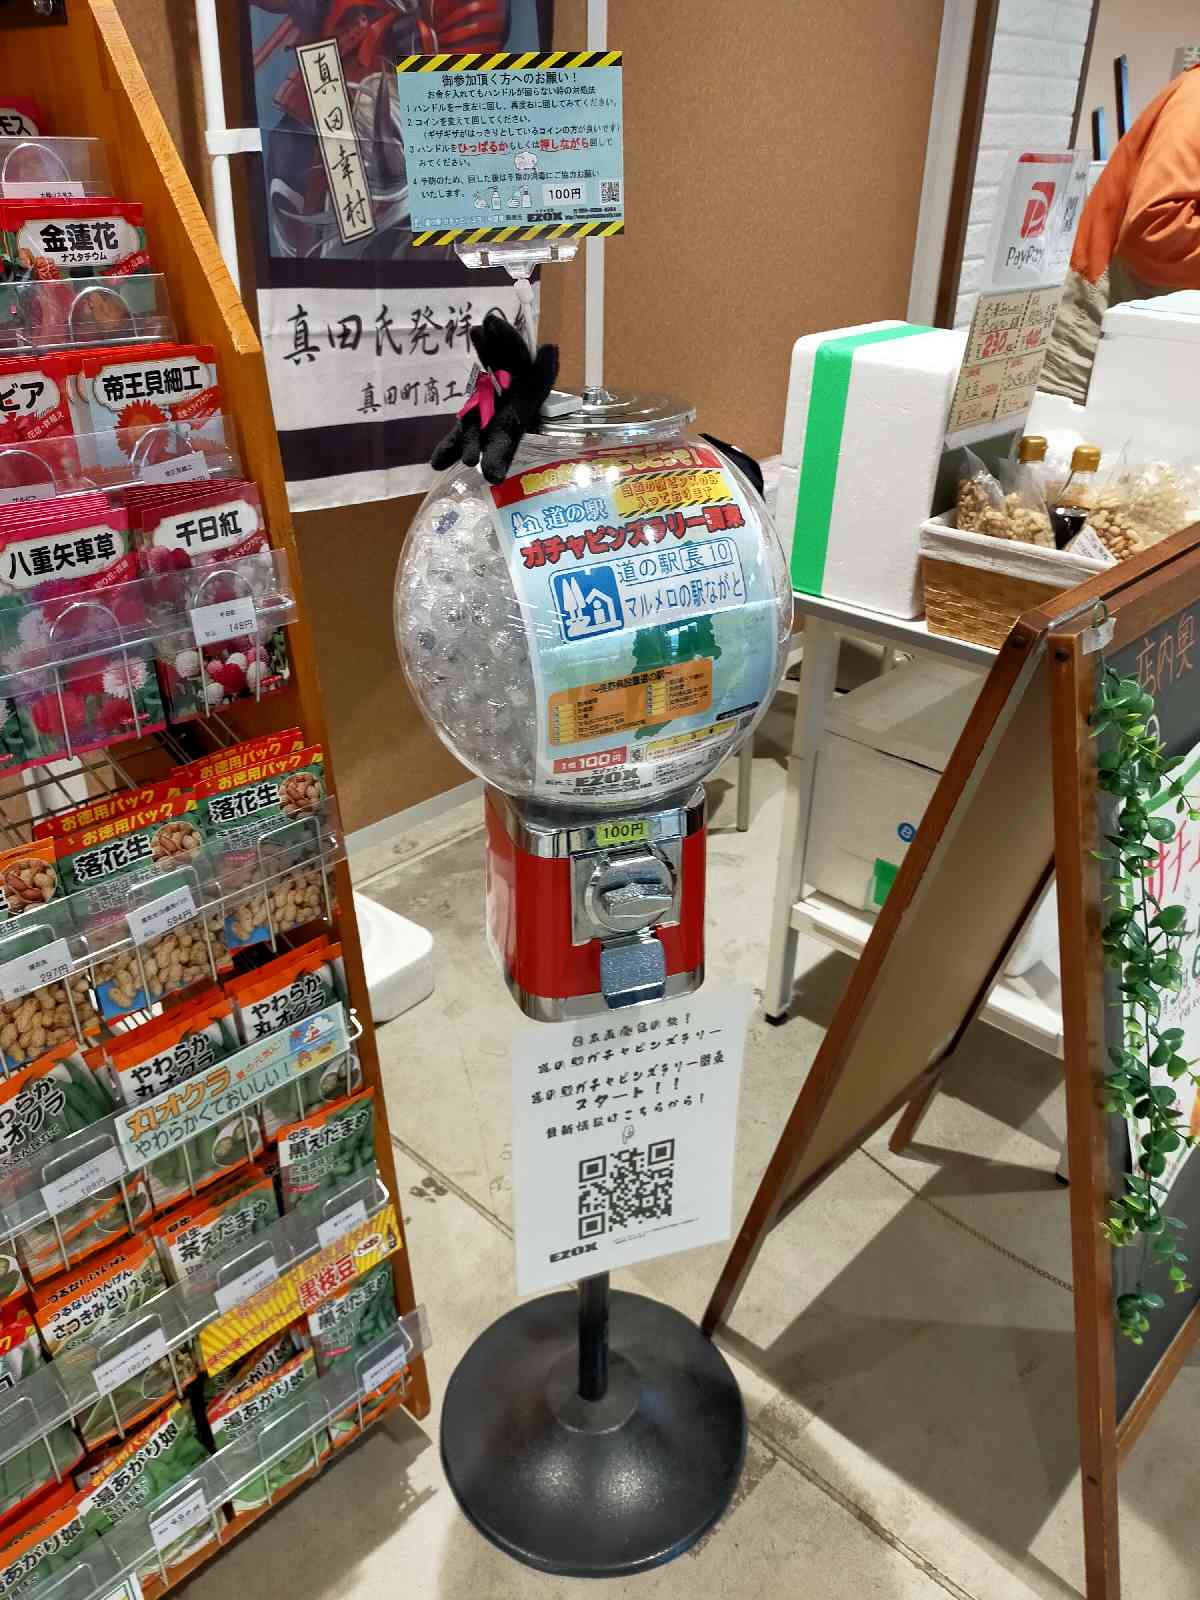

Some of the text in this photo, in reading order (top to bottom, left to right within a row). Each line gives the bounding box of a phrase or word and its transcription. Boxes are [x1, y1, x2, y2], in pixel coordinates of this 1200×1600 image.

[0, 115, 32, 137] モス
[313, 52, 369, 228] 真田幸村
[548, 187, 581, 201] 100円
[39, 221, 119, 253] 金蓮花
[1005, 244, 1046, 270] PayPay
[61, 252, 107, 264] ナスタチウム
[0, 380, 45, 411] ビア
[102, 365, 202, 402] 帝王貝細工
[356, 377, 467, 415] 真田町商工
[176, 510, 243, 547] 千日紅
[543, 497, 609, 530] 道の駅
[9, 532, 117, 580] 八重矢車草
[624, 571, 744, 619] マルメロの駅ながと
[81, 802, 173, 845] お徳用パック
[208, 783, 281, 824] 落花生
[603, 822, 644, 839] 100円
[72, 834, 153, 883] 落花生
[250, 974, 322, 1020] やわらか
[130, 1034, 209, 1084] やわらか
[127, 1065, 231, 1142] 丸オクラ
[576, 1077, 681, 1112] スタート！！
[288, 1110, 369, 1160] 黒えだまめ
[178, 1200, 268, 1263] 茶えだまめ
[549, 1241, 600, 1264] EZOX
[300, 1254, 356, 1308] 黒枝豆
[223, 1366, 305, 1432] 湯あがり娘
[92, 1421, 179, 1508] 湯あがり娘
